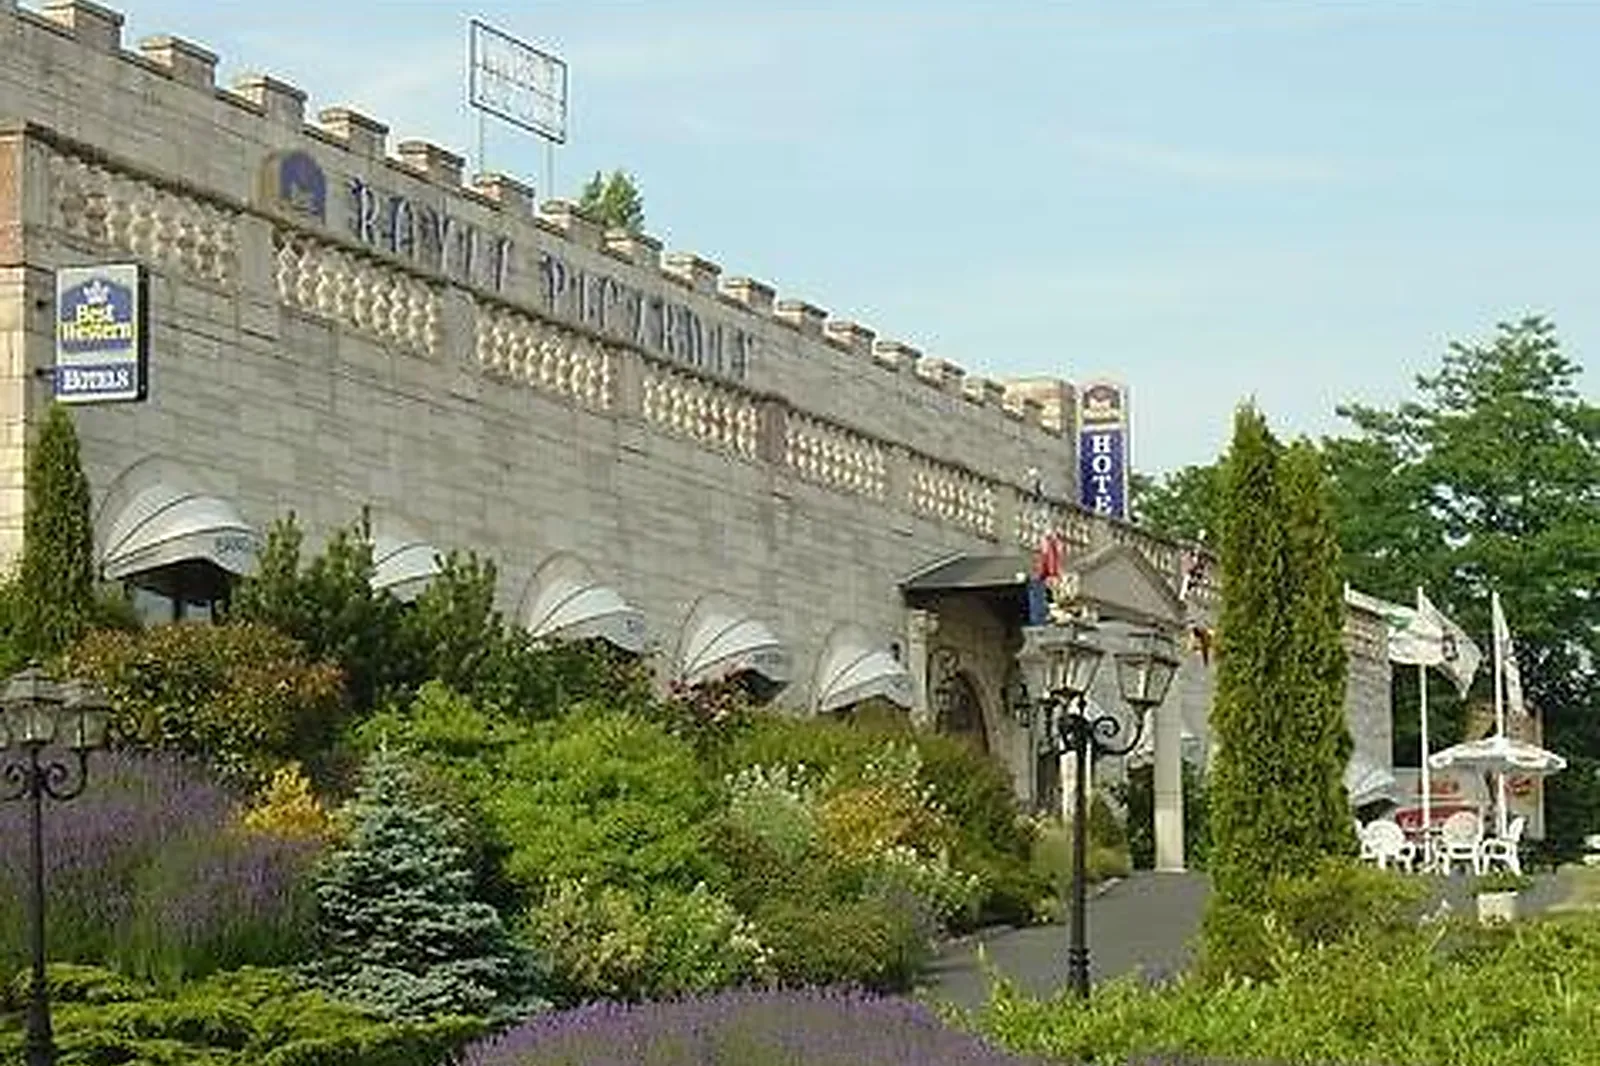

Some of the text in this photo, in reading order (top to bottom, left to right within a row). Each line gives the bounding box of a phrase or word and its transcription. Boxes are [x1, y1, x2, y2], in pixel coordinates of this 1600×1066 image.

[76, 303, 115, 324] Best
[62, 321, 132, 341] Western
[1091, 435, 1113, 515] HOTE
